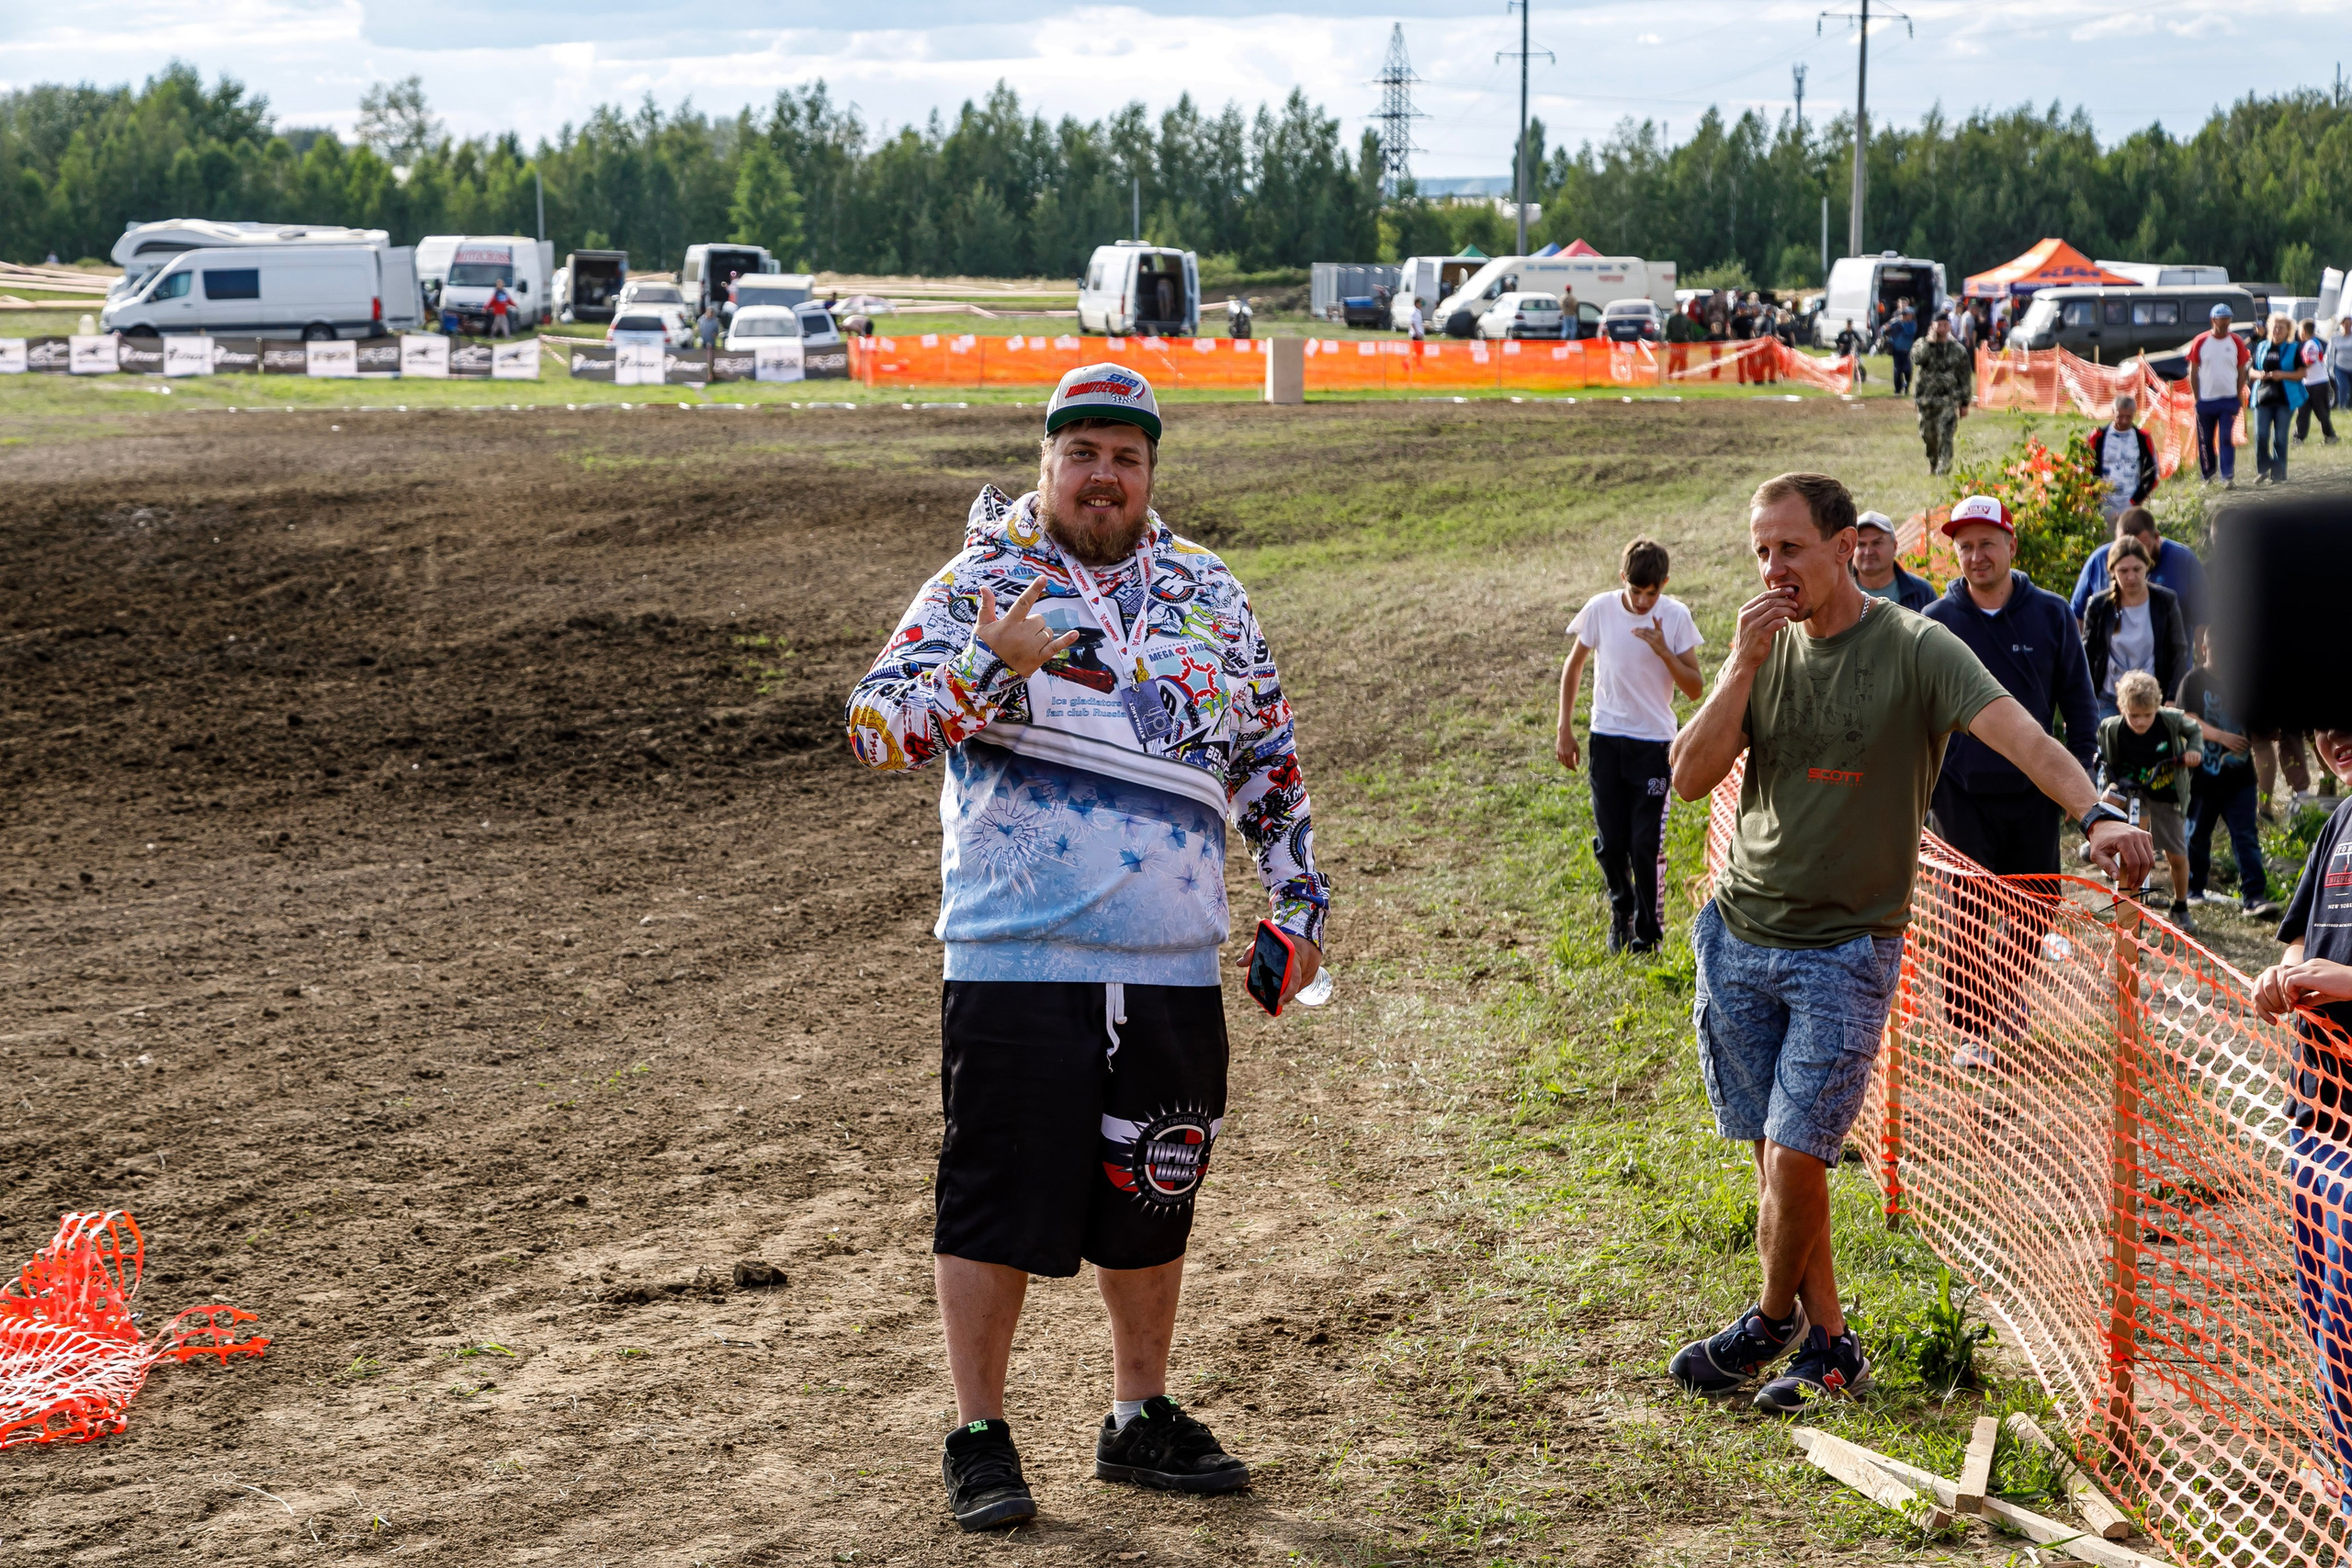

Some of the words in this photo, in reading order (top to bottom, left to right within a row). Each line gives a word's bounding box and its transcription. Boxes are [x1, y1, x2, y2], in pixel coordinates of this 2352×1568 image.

[1106, 373, 1139, 389] 919
[1148, 649, 1175, 662] MEGA
[1051, 696, 1067, 705] Ice
[1069, 696, 1123, 707] gladiators
[1046, 708, 1063, 717] fan
[1067, 707, 1091, 716] club
[1092, 708, 1126, 718] Russia
[1807, 768, 1864, 783] SCOTT
[1647, 778, 1668, 795] 23
[1149, 1122, 1165, 1135] Ice
[1168, 1115, 1198, 1125] racing
[1155, 1163, 1197, 1181] ШААЗ
